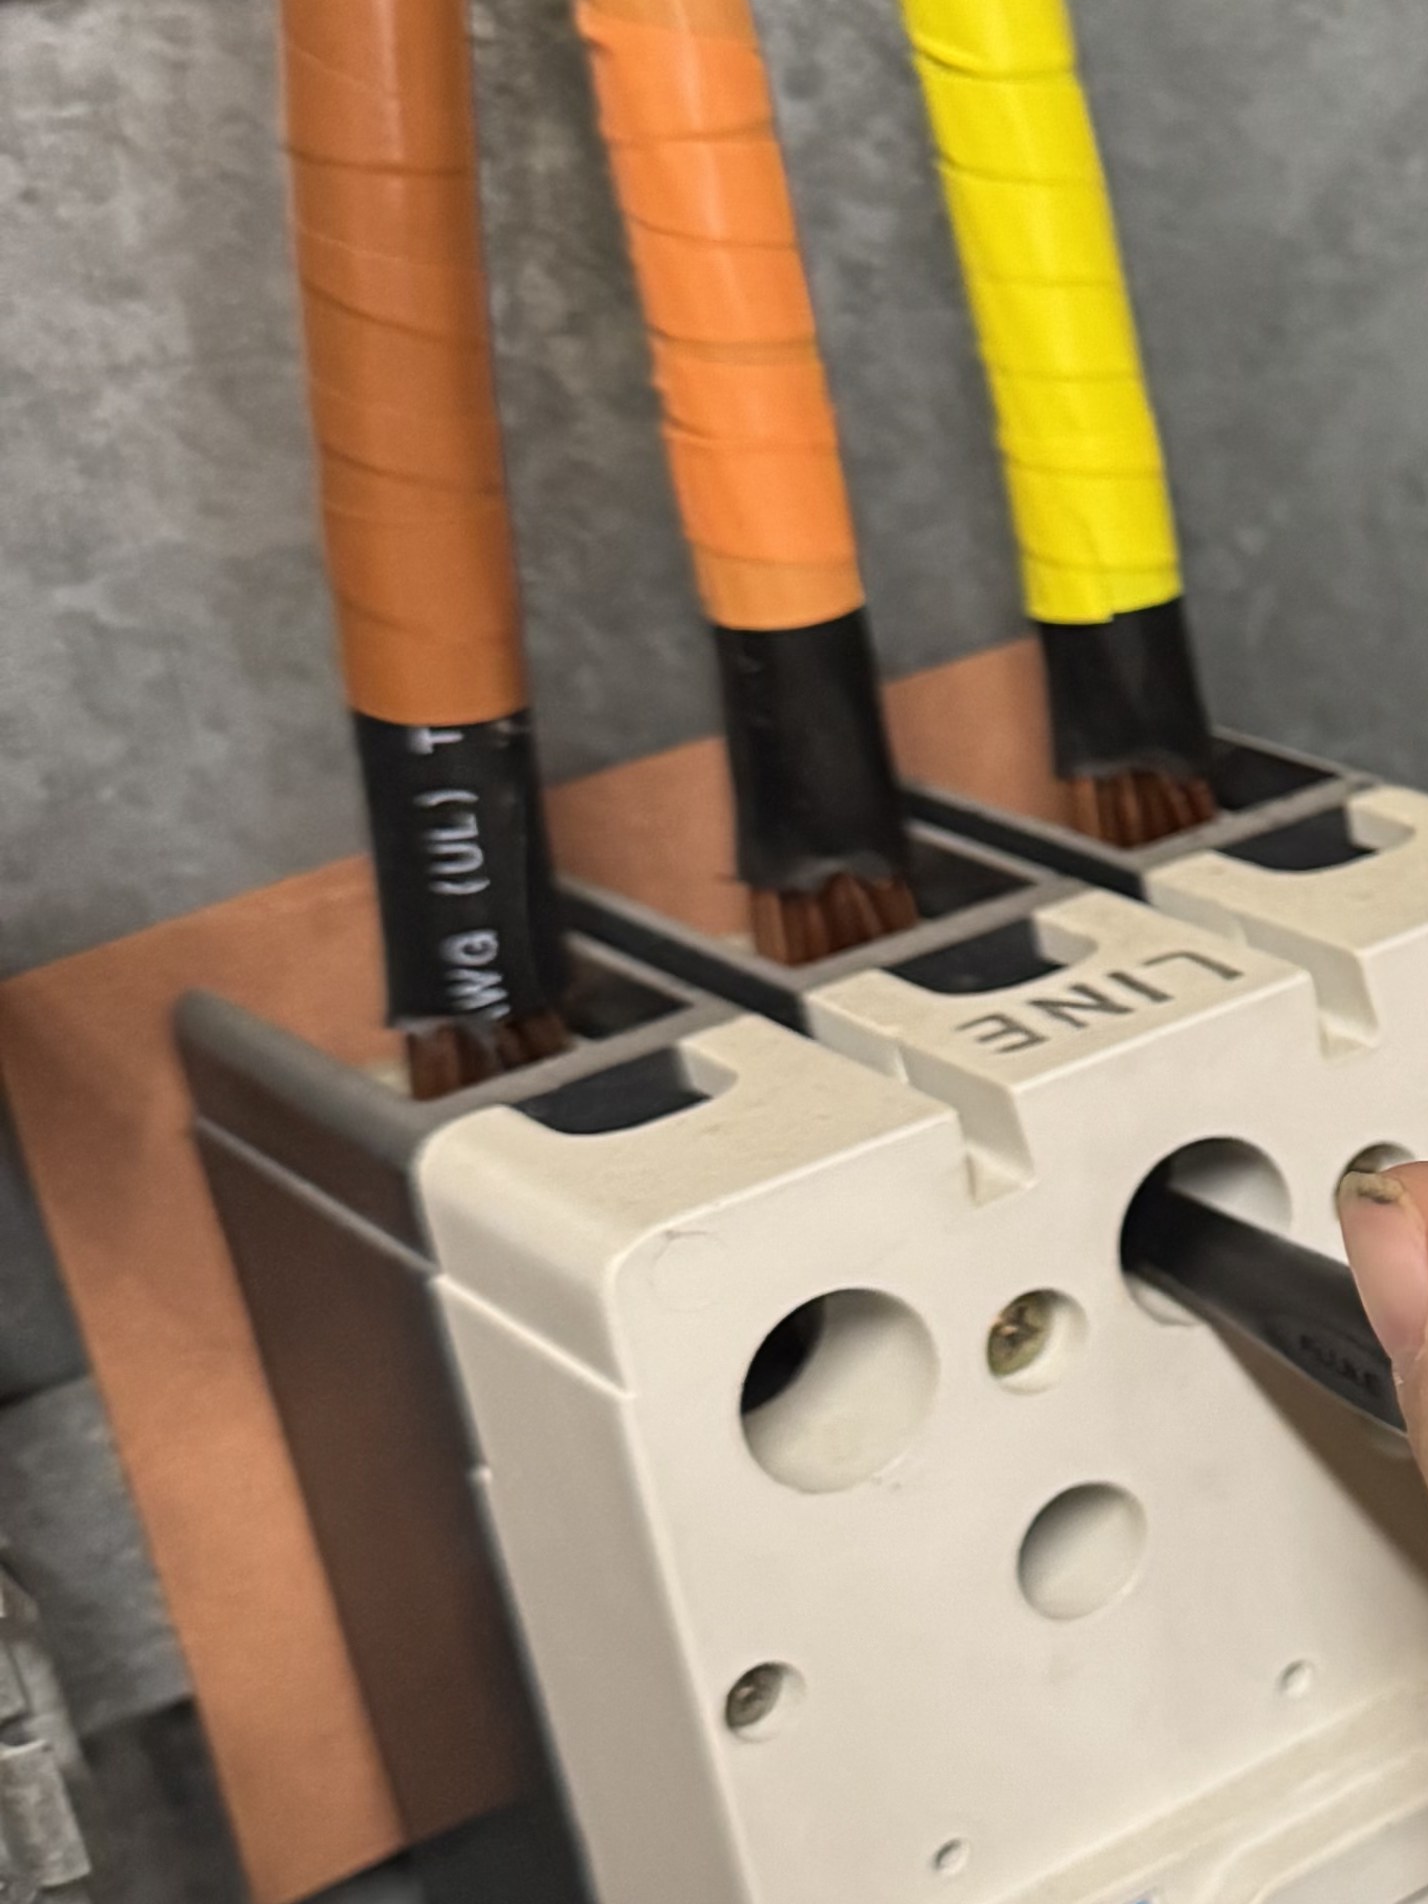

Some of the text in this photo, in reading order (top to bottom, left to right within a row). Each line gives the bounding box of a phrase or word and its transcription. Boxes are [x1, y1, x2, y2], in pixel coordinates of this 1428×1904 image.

[413, 788, 491, 895] (UL)
[442, 928, 511, 1019] WG
[954, 950, 1244, 1054] LINE
